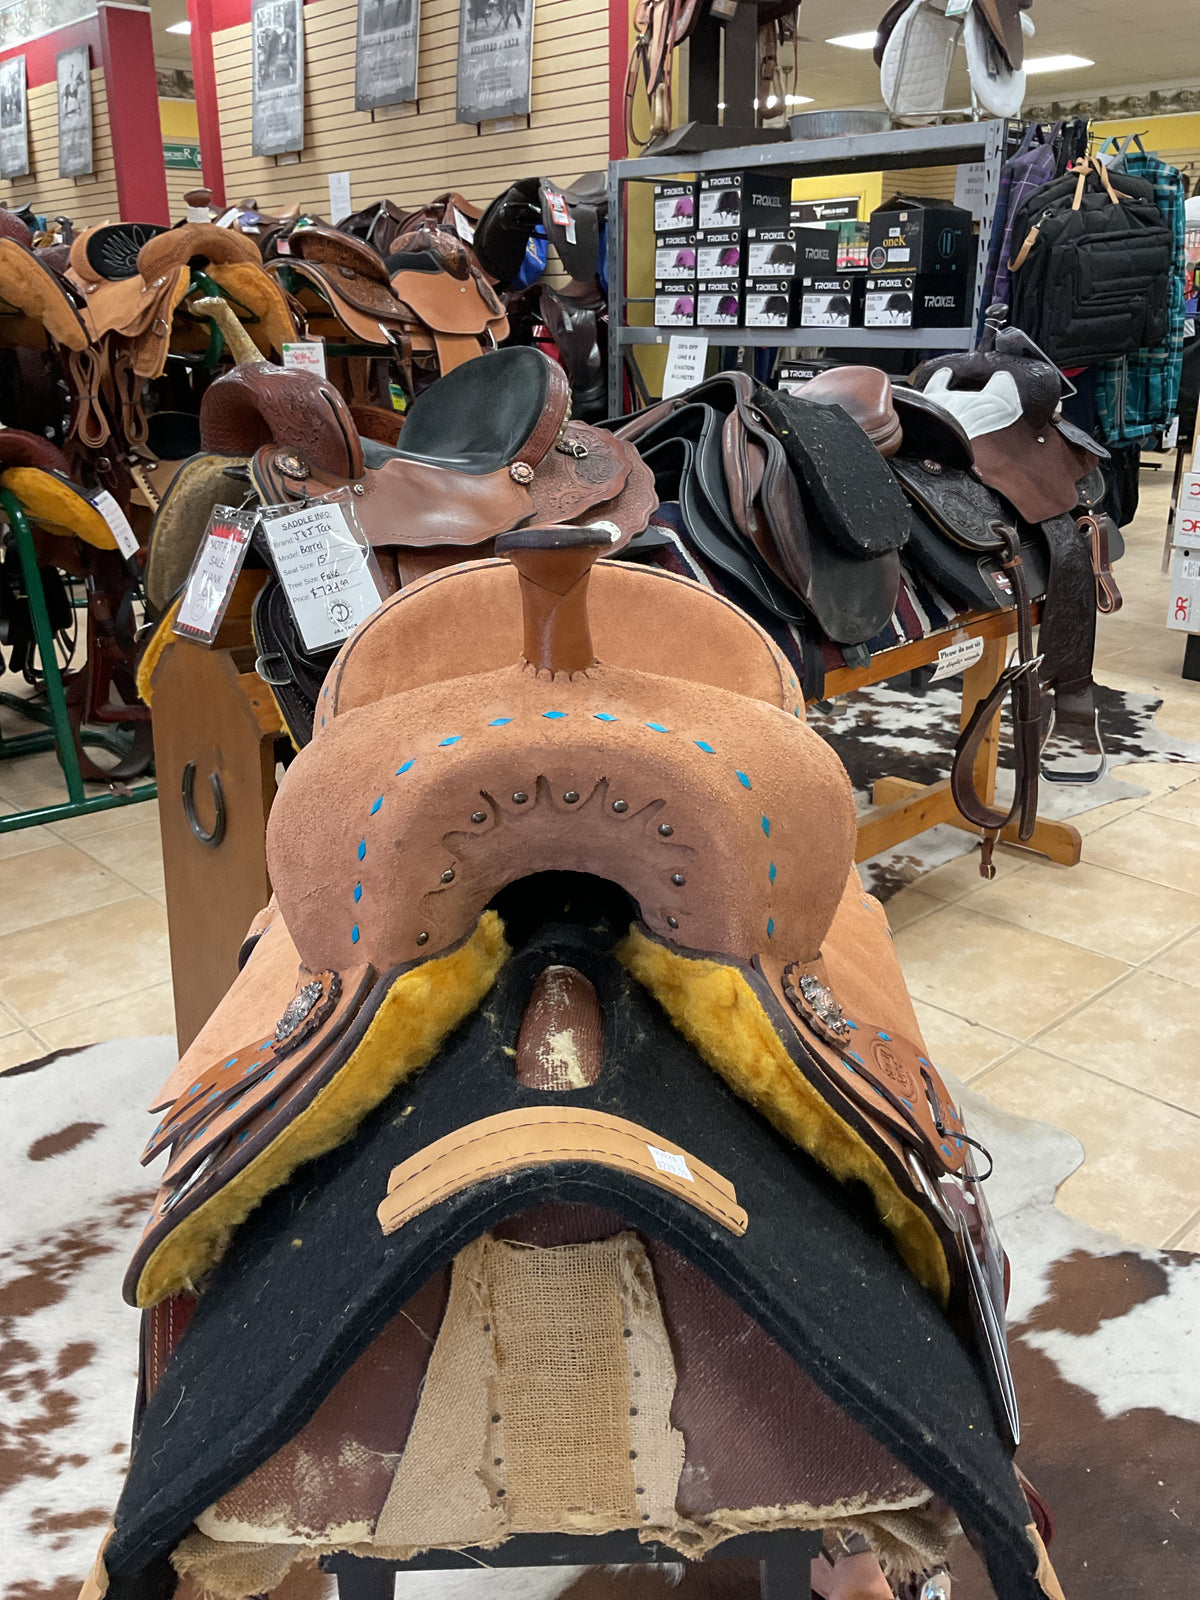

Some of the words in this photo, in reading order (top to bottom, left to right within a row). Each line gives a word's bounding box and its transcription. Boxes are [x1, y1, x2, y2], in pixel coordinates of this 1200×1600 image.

[710, 177, 733, 186] TROXEL
[663, 187, 685, 196] TROXEL
[751, 194, 782, 208] TROXEL
[707, 234, 730, 243] TROXEL
[760, 232, 785, 240] TROXEL
[665, 237, 687, 245] TROXEL
[882, 234, 907, 248] oneK
[804, 248, 830, 260] TROXEL
[664, 284, 686, 292] TROXEL
[707, 282, 730, 291] TROXEL
[755, 283, 779, 292] TROXEL
[814, 281, 841, 290] TROXEL
[877, 279, 903, 288] TROXEL
[924, 295, 956, 308] TROXEL
[789, 370, 814, 378] TROXEL
[281, 515, 314, 531] SADDLE
[299, 541, 323, 555] Barrel
[209, 555, 225, 569] SALE
